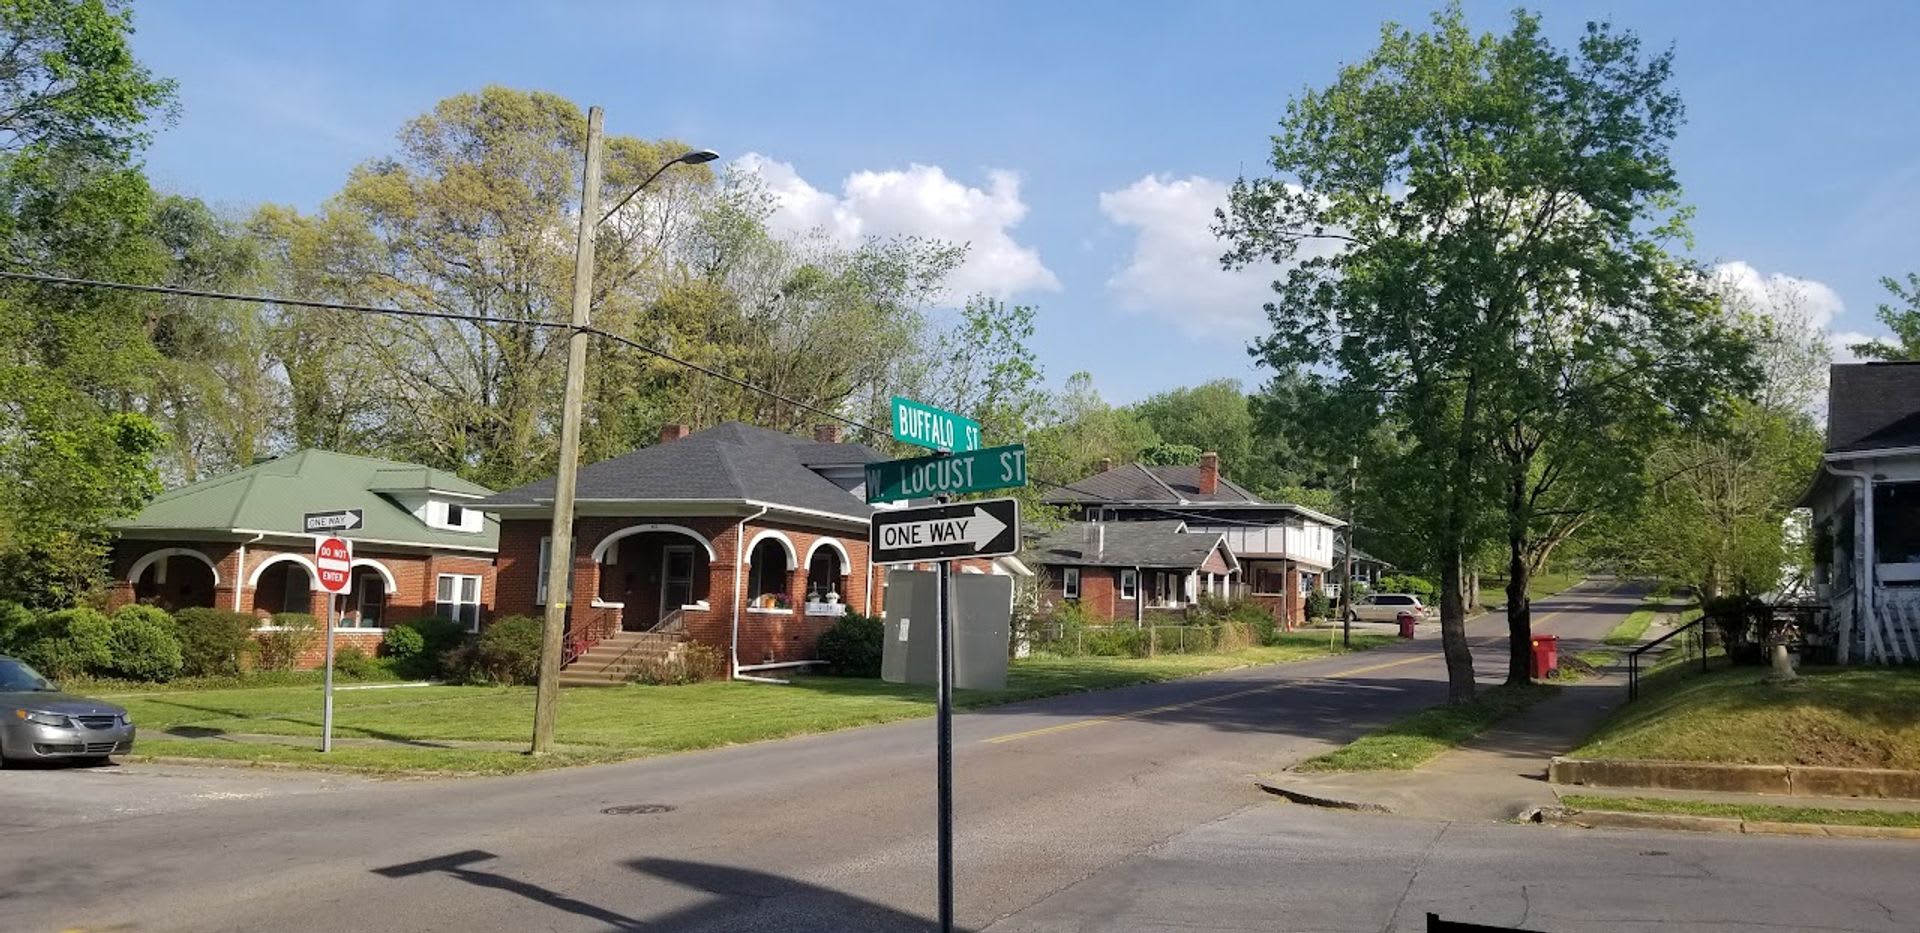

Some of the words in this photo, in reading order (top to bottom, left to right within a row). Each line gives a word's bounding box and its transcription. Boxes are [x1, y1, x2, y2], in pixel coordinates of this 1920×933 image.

[899, 404, 954, 448] BUFFALO
[966, 425, 978, 450] ST
[866, 468, 884, 498] W.
[901, 457, 975, 495] LOCUST
[1000, 450, 1024, 482] ST
[309, 519, 326, 528] ONE
[328, 517, 346, 526] WAY
[884, 524, 922, 546] ONE
[930, 520, 969, 542] WAY
[321, 547, 331, 556] DO
[334, 549, 347, 559] NOT
[322, 571, 343, 582] ENTER
